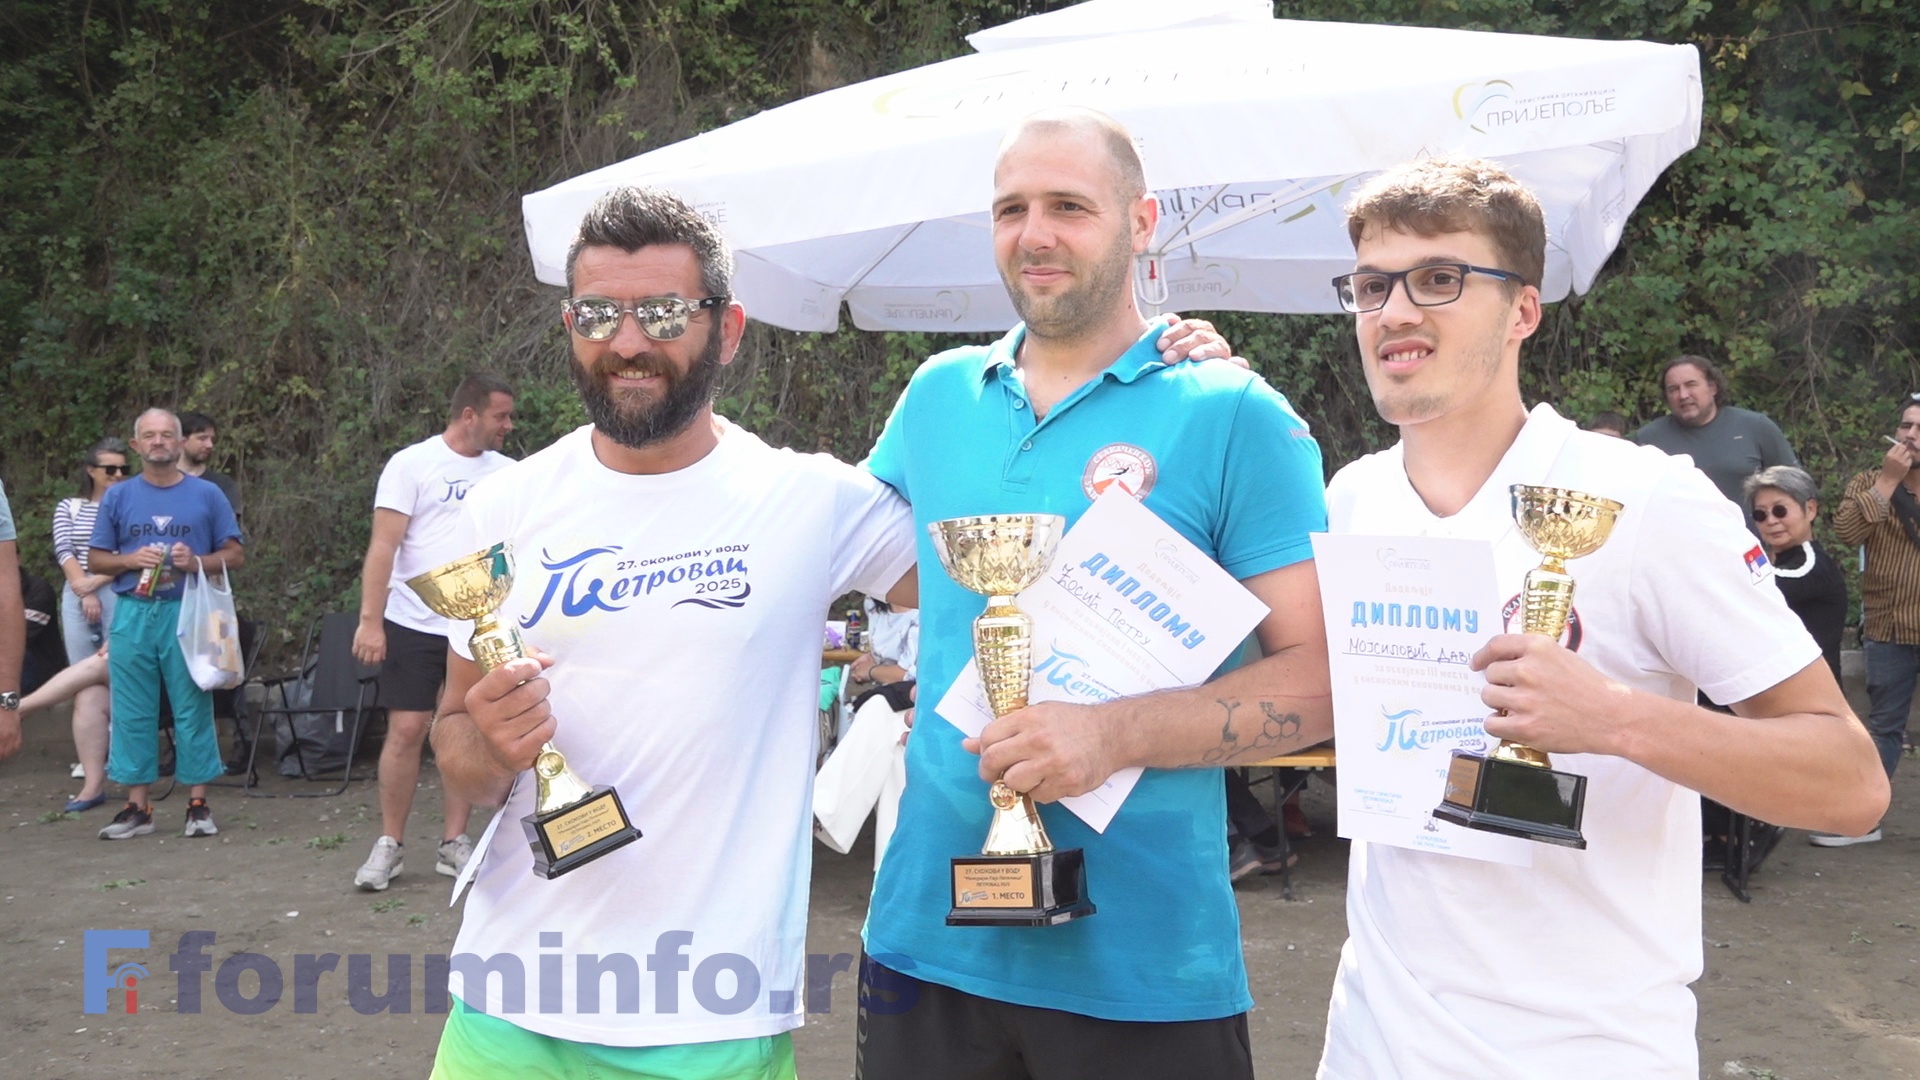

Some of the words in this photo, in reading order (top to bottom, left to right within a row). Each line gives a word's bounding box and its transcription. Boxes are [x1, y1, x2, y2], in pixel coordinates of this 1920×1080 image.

[1487, 96, 1617, 127] ПРИЈЕПОЉЕ
[130, 523, 191, 537] GROUP
[617, 560, 637, 571] 27.
[716, 543, 750, 553] воду
[695, 578, 741, 594] 2025
[1080, 552, 1206, 650] ДИПЛОМУ
[1351, 601, 1478, 633] ДИПЛОМУ
[1459, 739, 1482, 747] 2025
[594, 820, 617, 835] МЕСТО
[1000, 892, 1025, 900] МЕСТО
